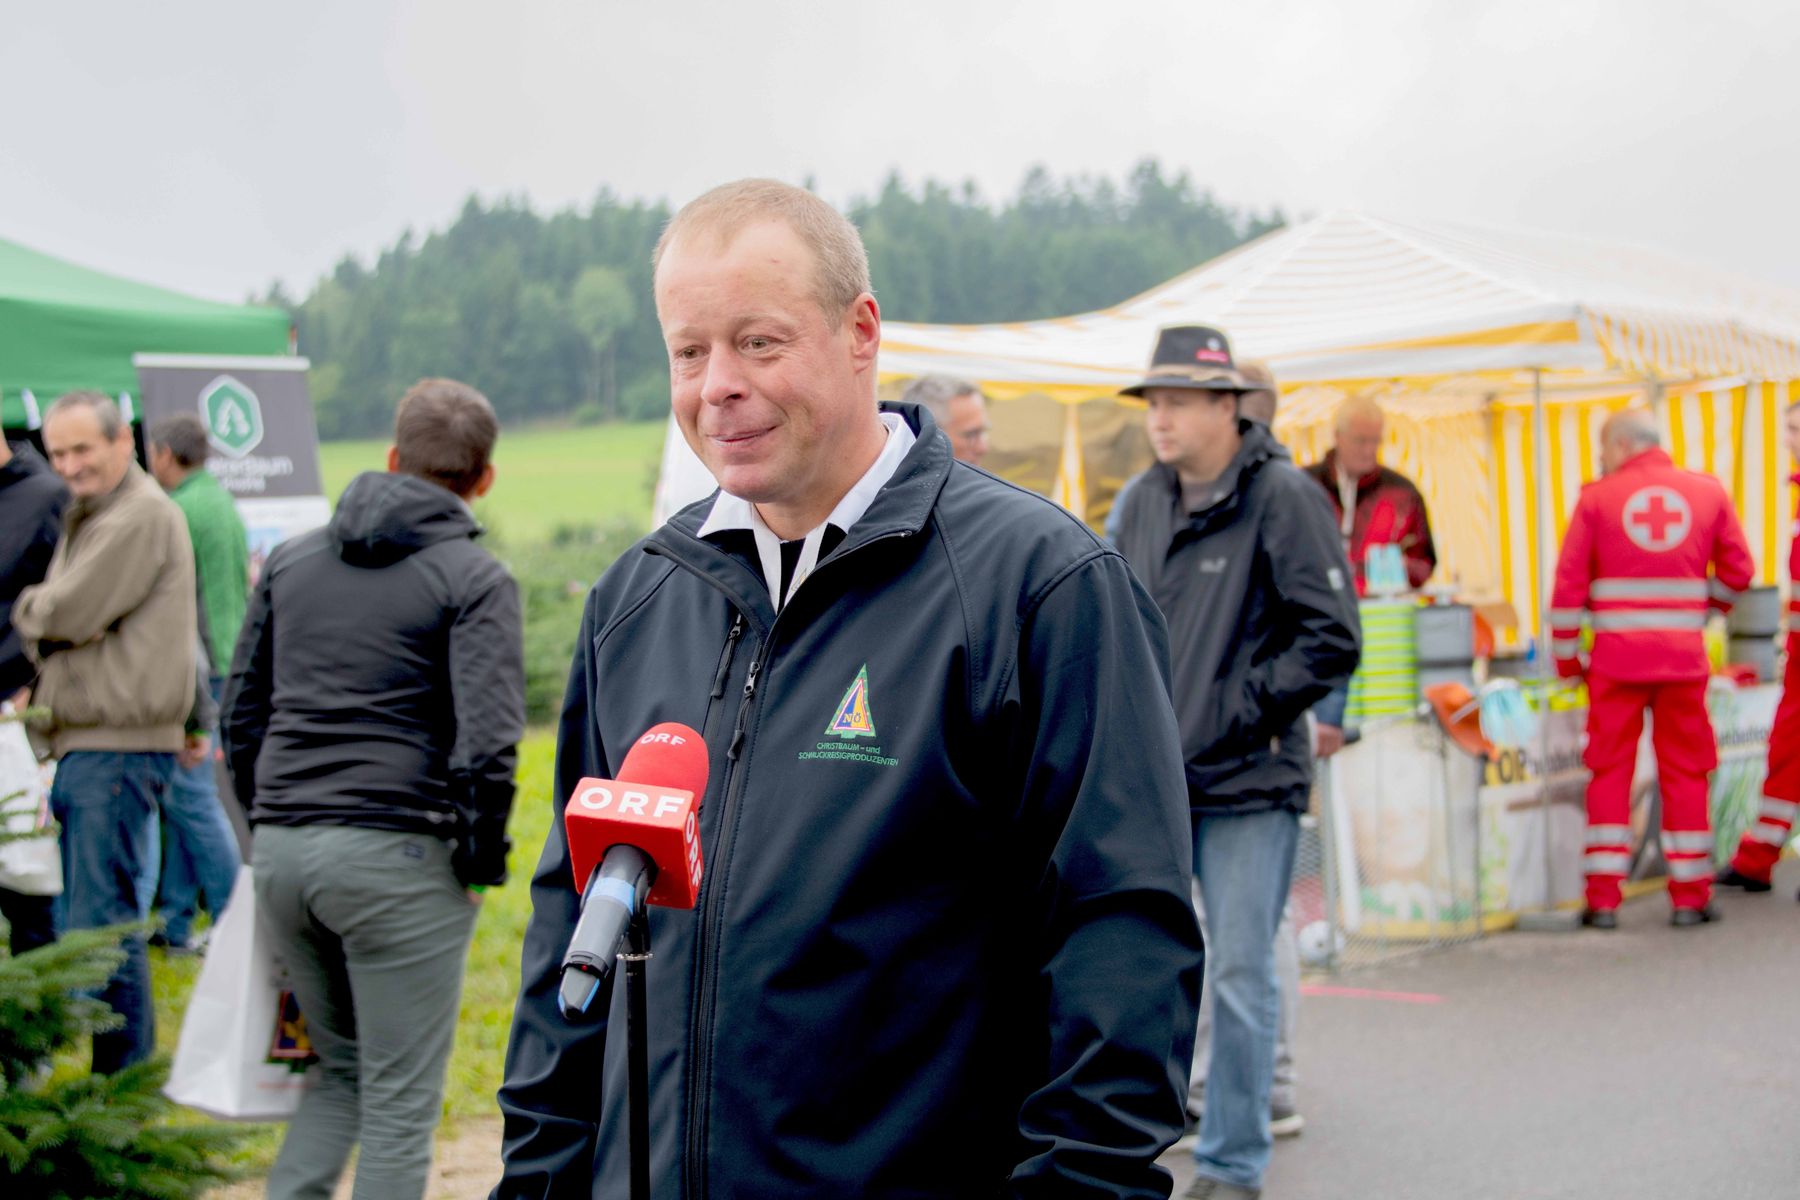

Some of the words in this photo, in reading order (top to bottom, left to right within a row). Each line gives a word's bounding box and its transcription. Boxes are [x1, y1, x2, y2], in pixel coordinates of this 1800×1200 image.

[842, 712, 861, 723] NÖ
[640, 732, 687, 747] ORF
[798, 751, 899, 766] SCHMUCKREISIGPRODUZENTEN
[579, 786, 685, 818] ORF
[685, 810, 702, 888] ORF
